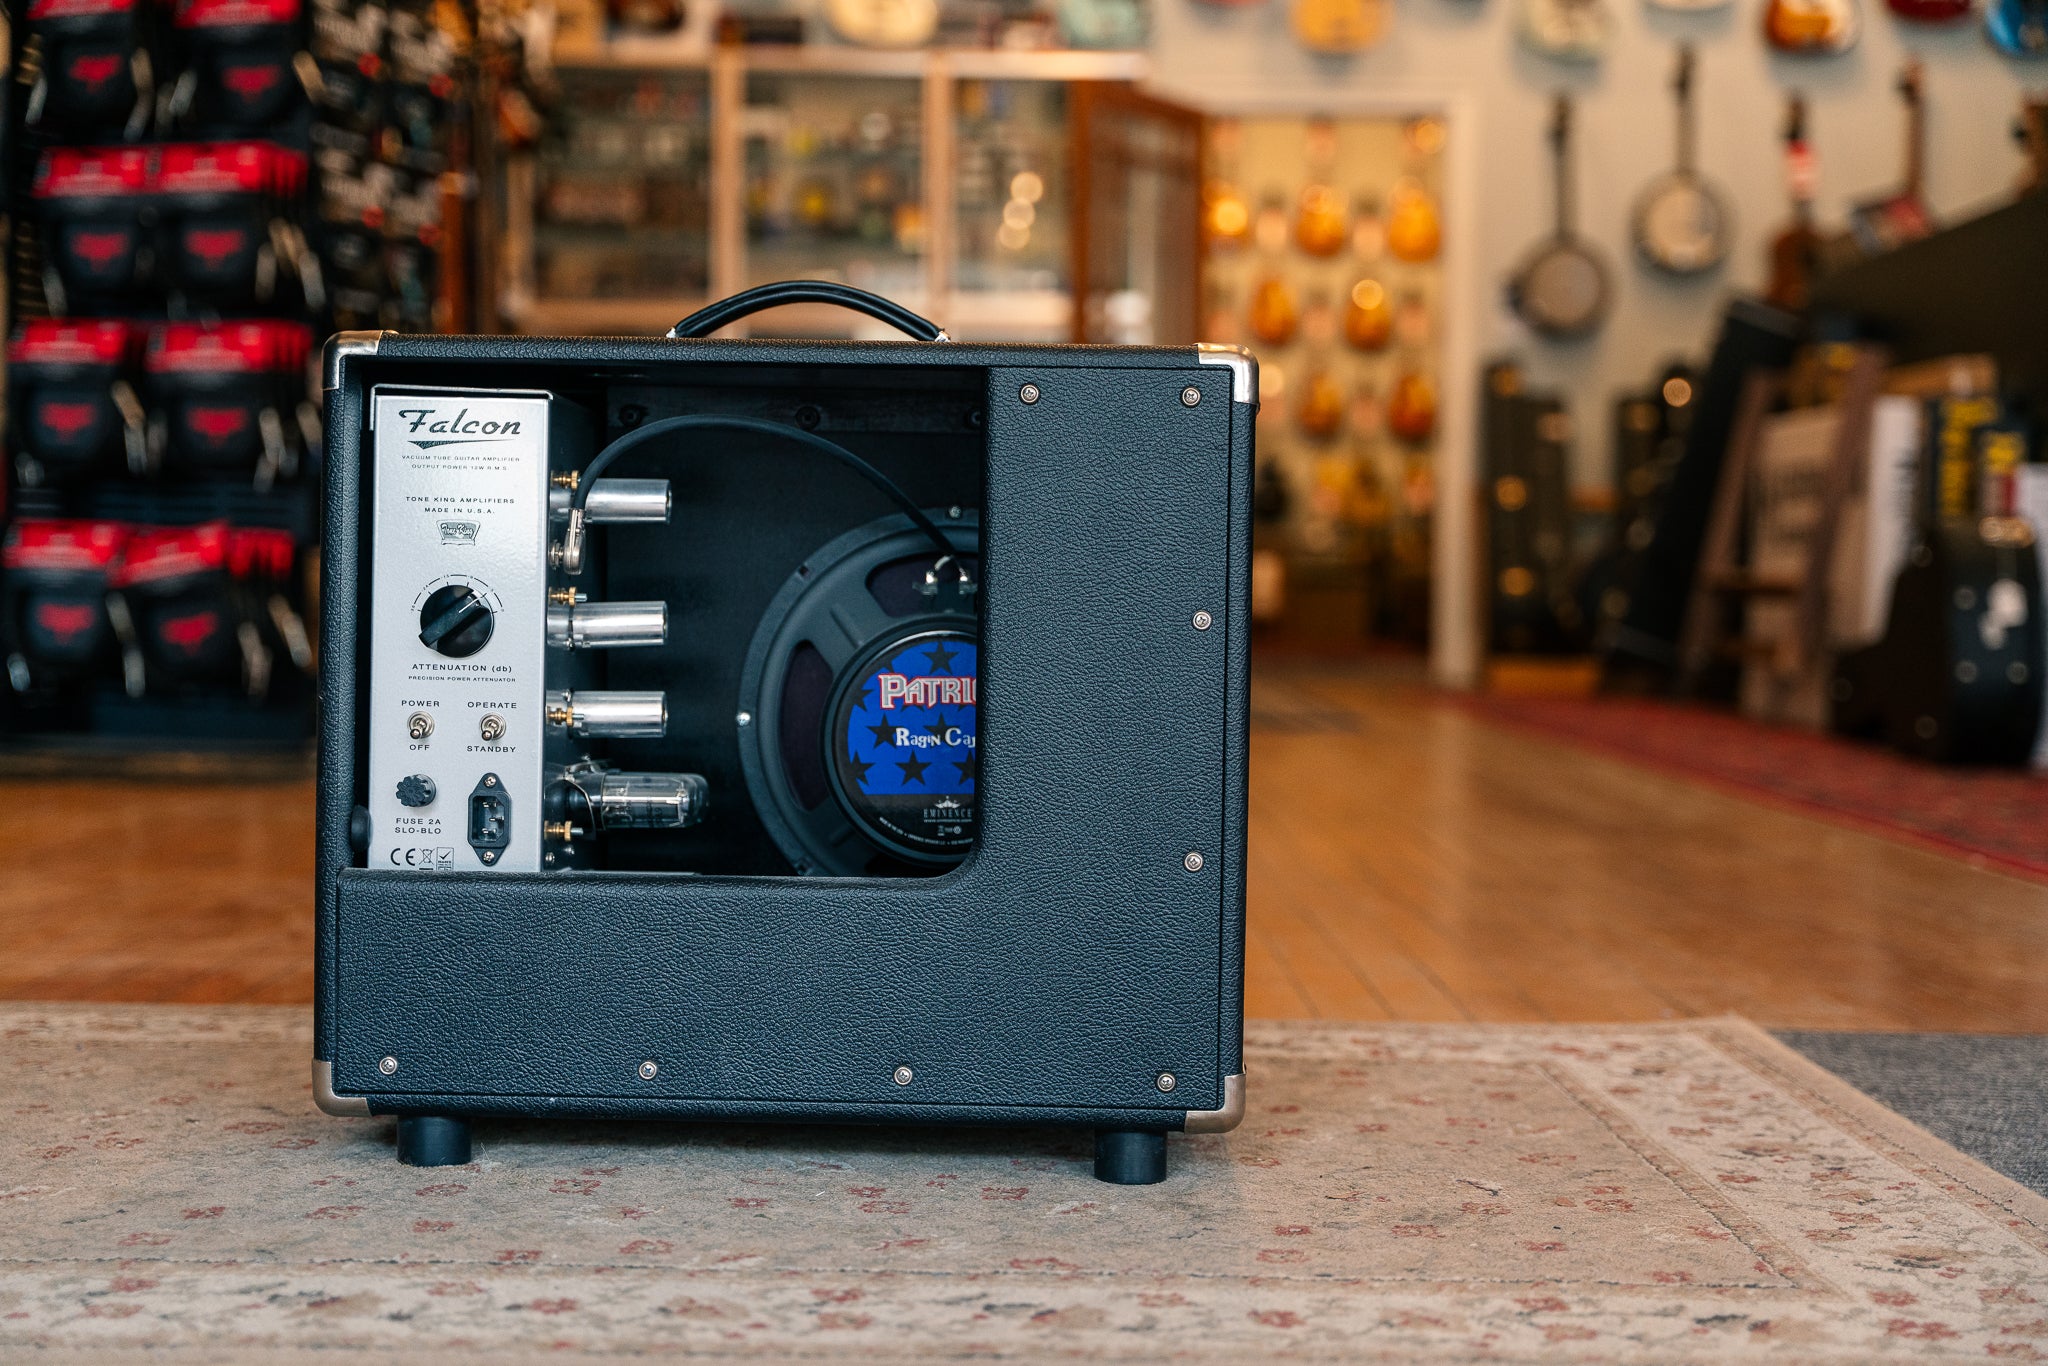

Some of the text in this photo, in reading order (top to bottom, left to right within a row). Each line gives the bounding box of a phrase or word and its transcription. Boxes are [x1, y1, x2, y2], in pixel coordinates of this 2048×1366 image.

[398, 408, 521, 435] Falcon
[412, 663, 513, 673] ATTENUATION (db)
[878, 674, 977, 709] PATRI
[401, 699, 440, 707] POWER
[467, 701, 517, 709] OPERATE
[467, 745, 516, 753] STANDBY
[923, 808, 973, 818] EMINENCE
[395, 817, 424, 825] FUSE
[394, 827, 442, 835] SLO-BLO
